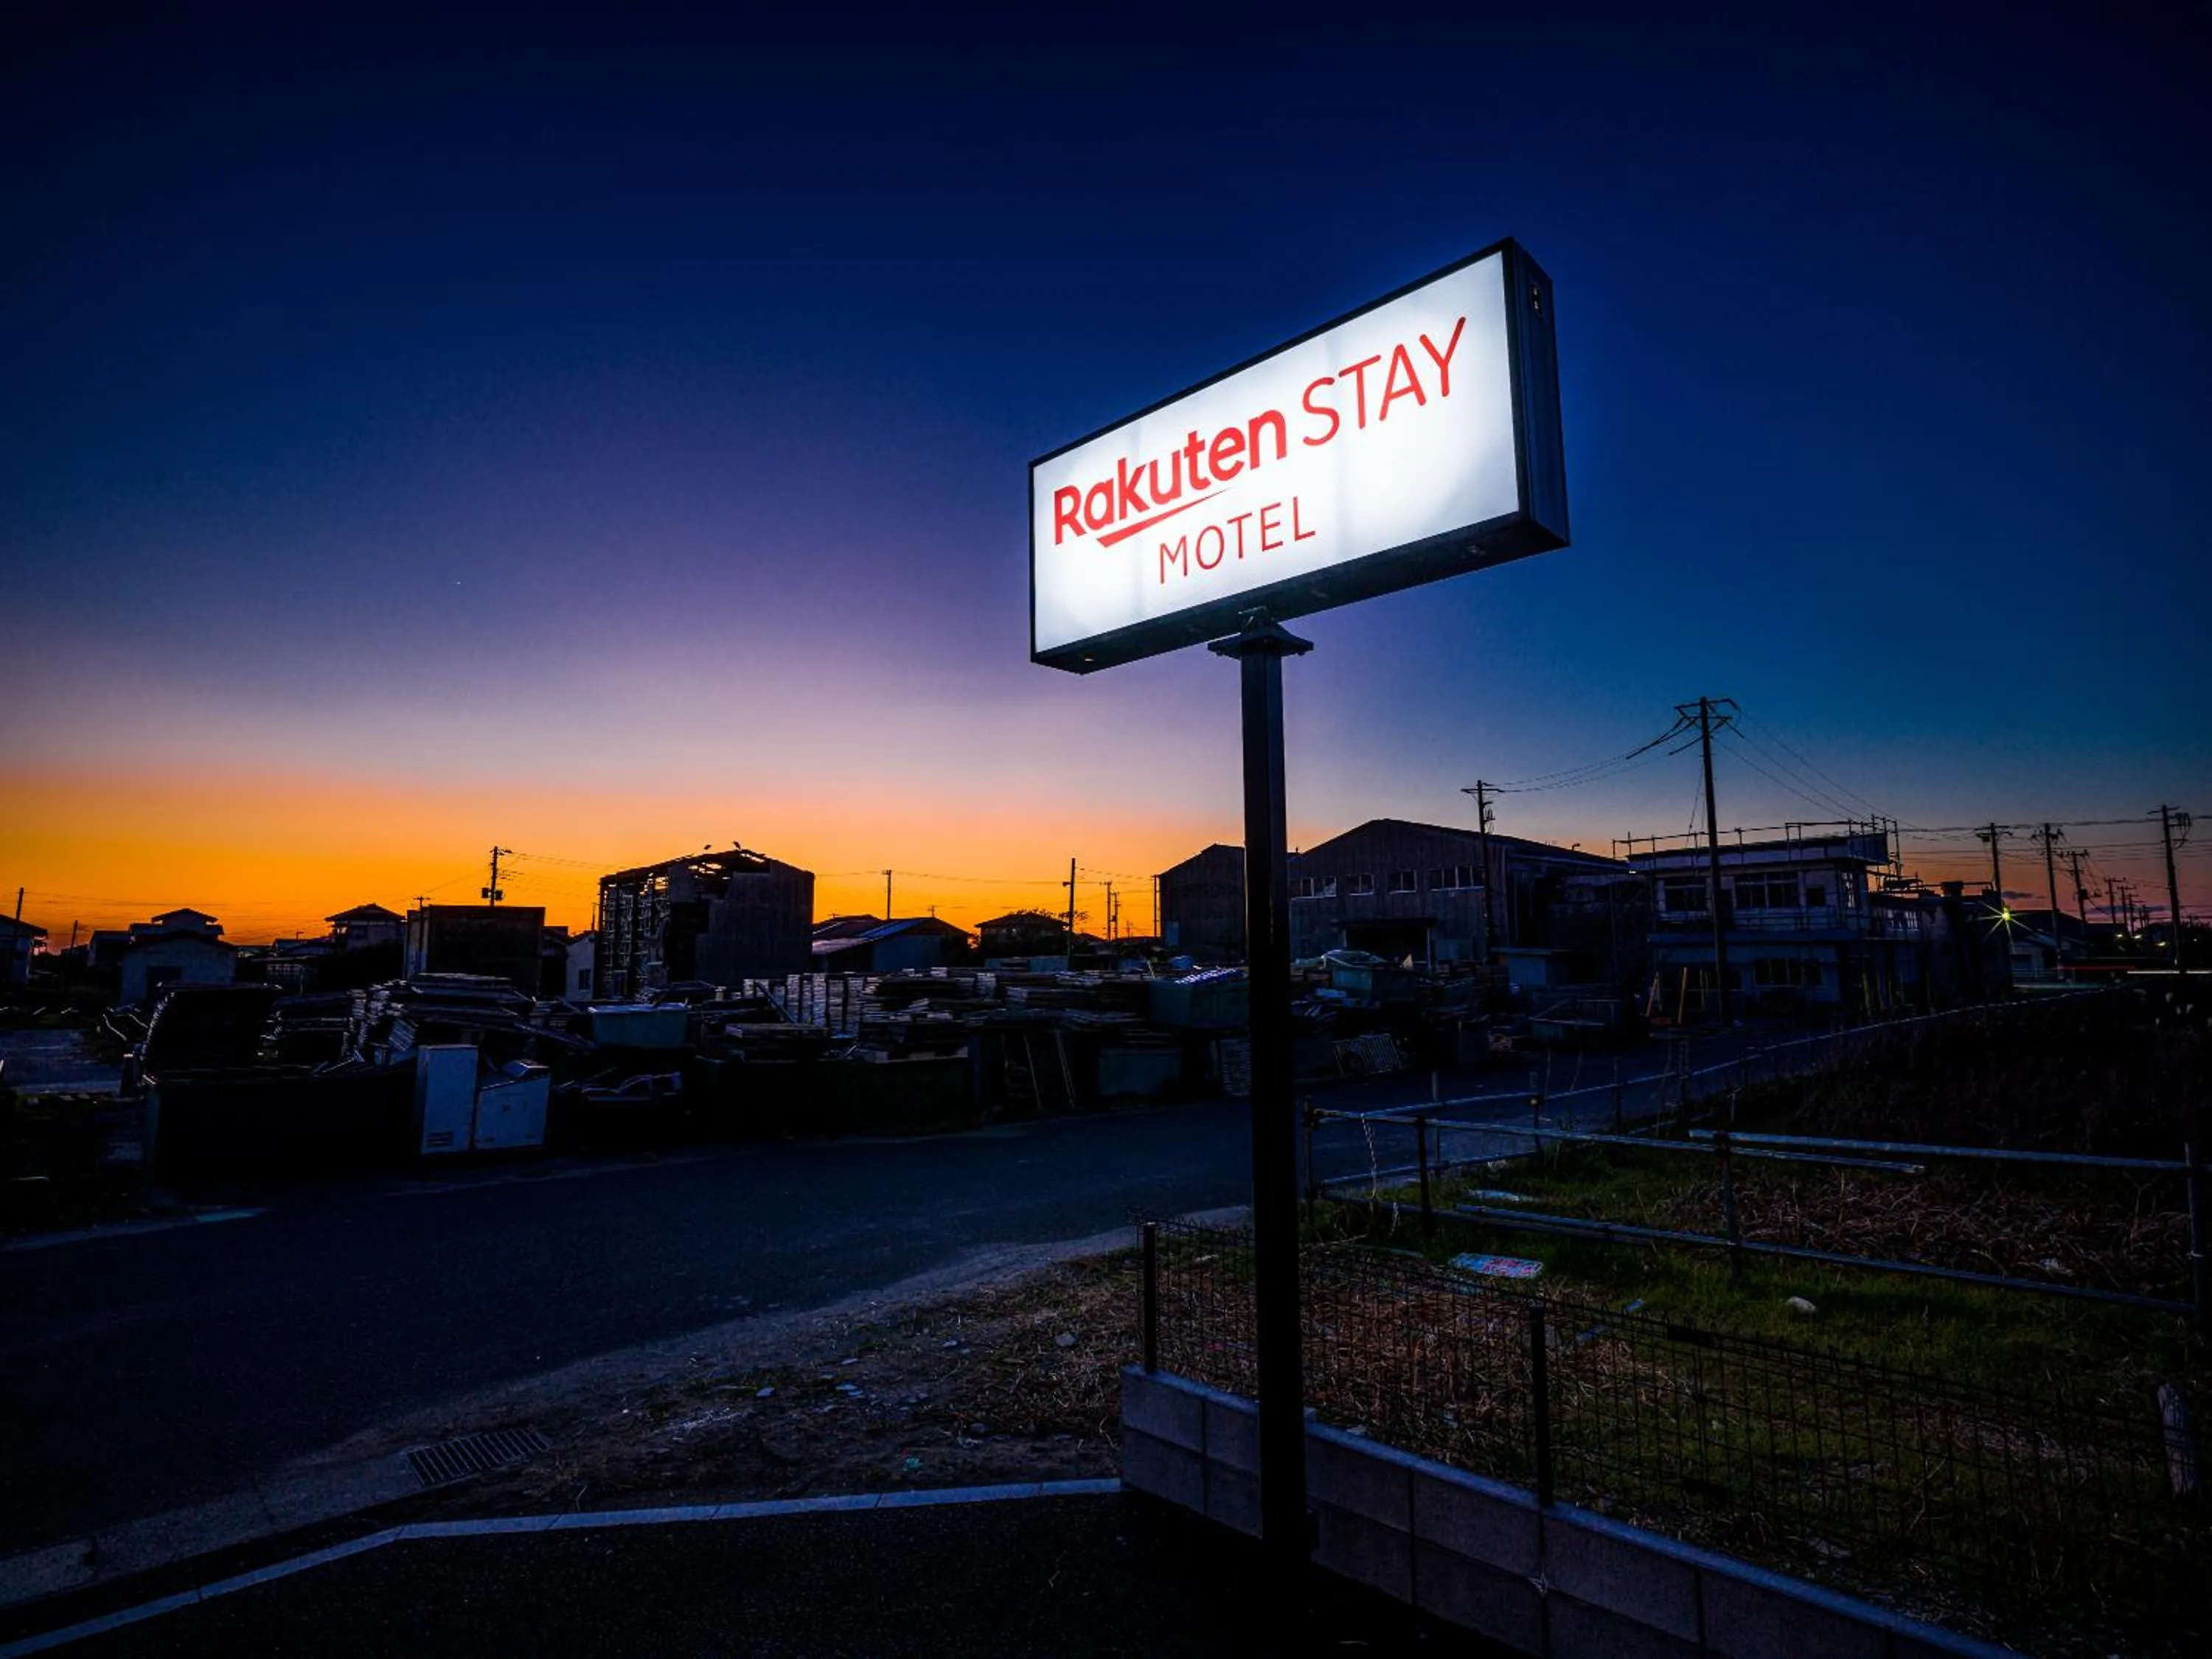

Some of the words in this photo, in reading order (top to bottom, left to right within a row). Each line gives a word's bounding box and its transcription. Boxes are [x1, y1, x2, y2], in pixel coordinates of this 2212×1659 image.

[1054, 408, 1287, 547] Rakuten
[1301, 316, 1467, 447] STAY
[1158, 495, 1316, 585] MOTEL
